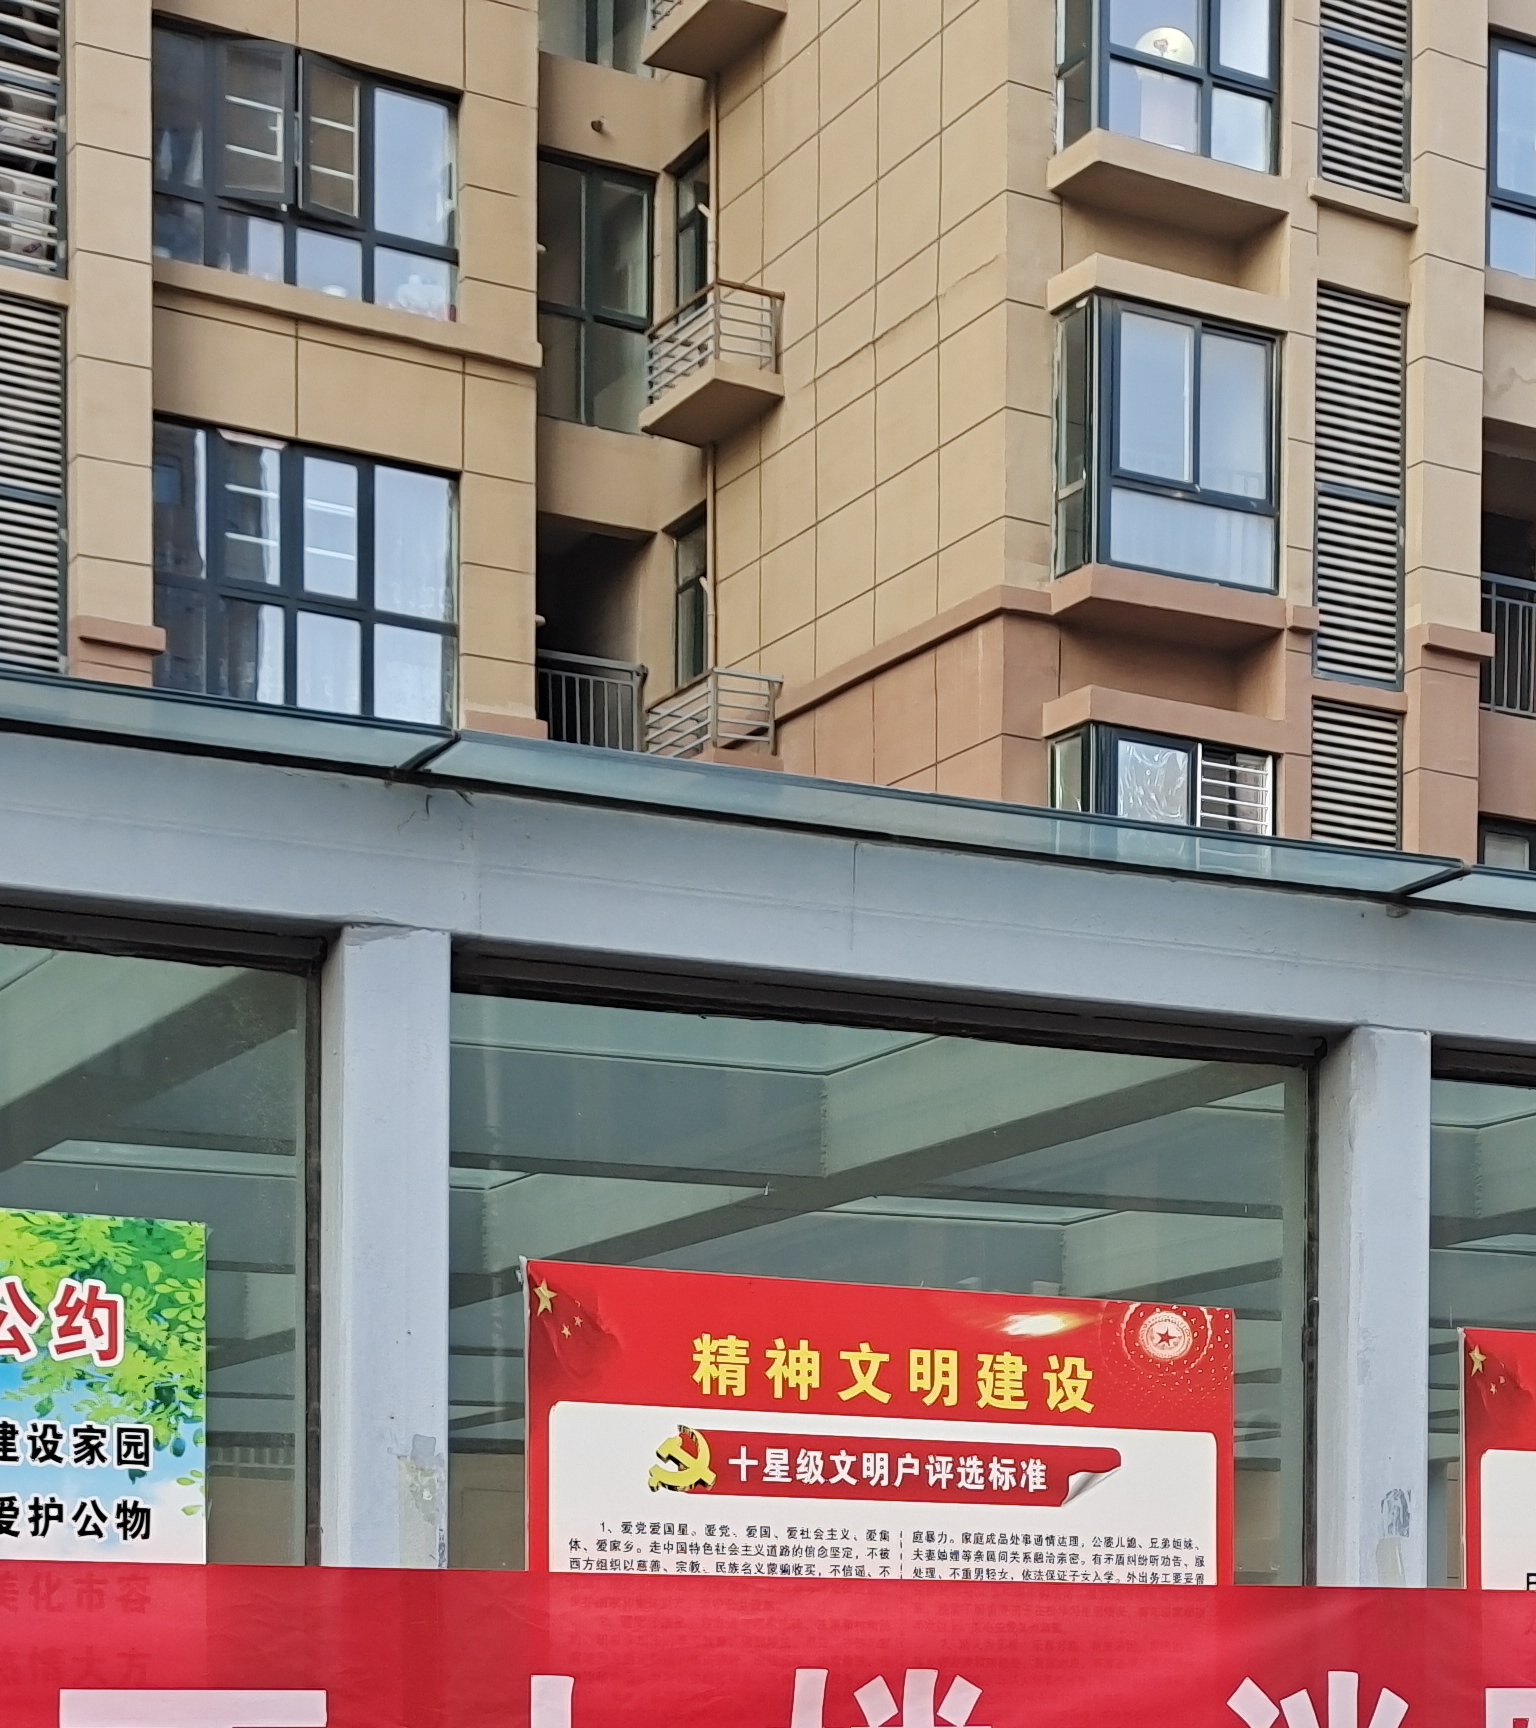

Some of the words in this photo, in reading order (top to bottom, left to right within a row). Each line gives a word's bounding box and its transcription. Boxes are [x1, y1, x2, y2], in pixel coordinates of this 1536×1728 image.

[692, 1332, 1097, 1414] 精神文明建设
[728, 1446, 1048, 1494] 十星级文明户评选标准
